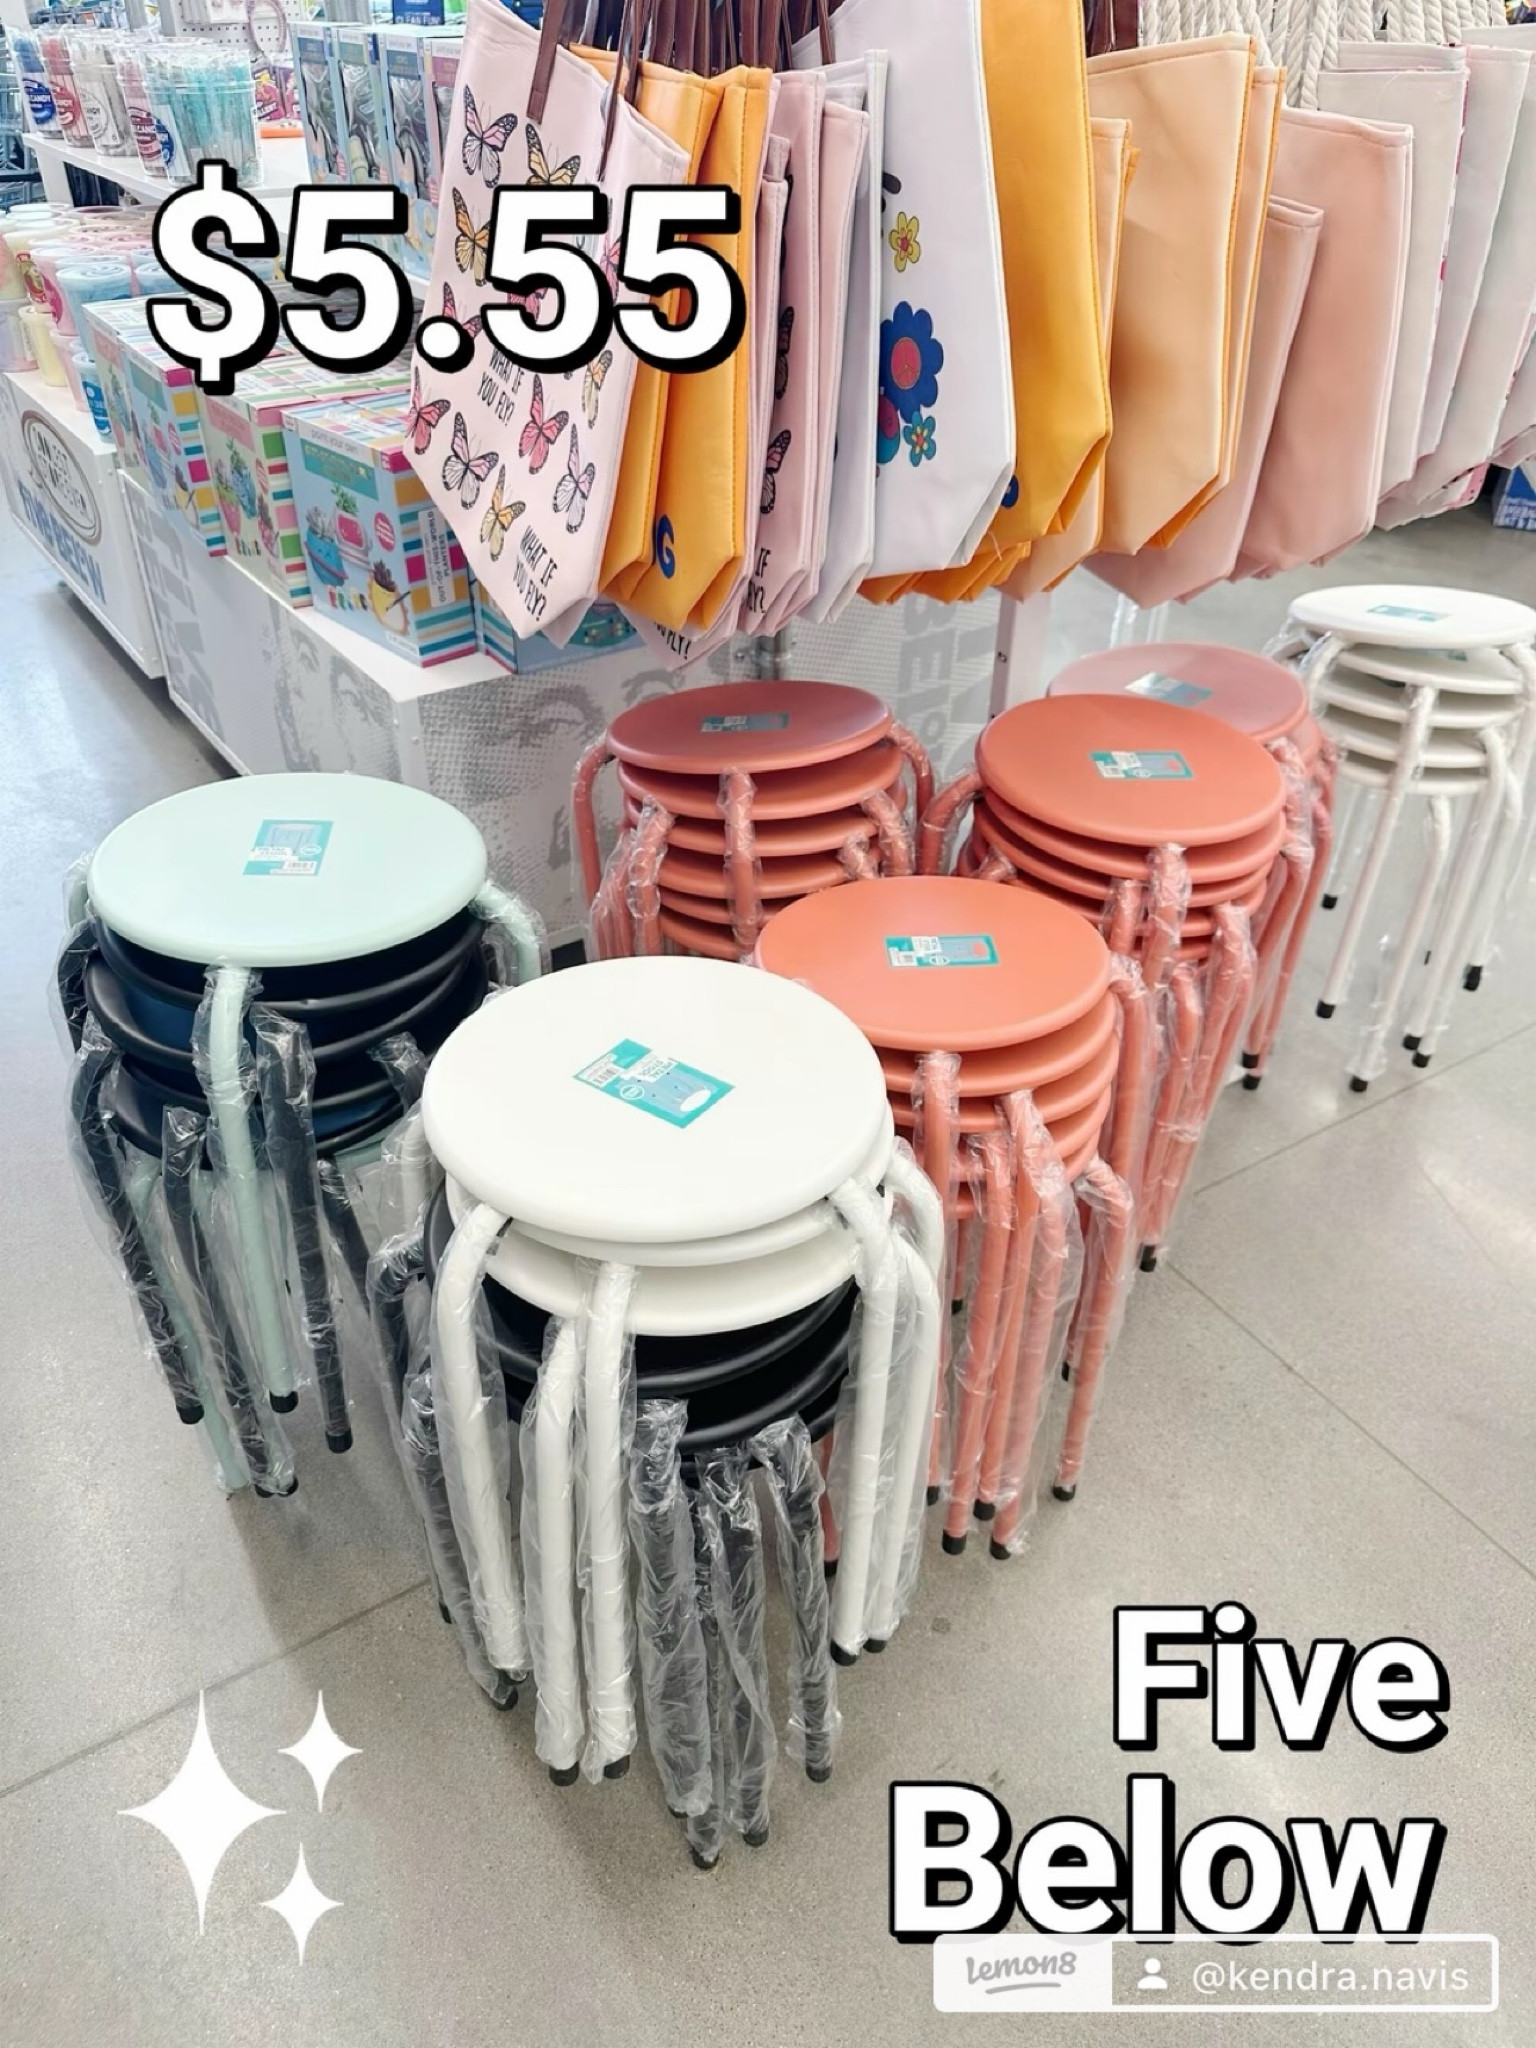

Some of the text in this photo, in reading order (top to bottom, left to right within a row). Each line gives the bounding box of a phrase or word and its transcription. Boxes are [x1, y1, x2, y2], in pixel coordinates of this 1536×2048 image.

[477, 371, 515, 427] YOU FLY?
[520, 524, 558, 588] WHAT IF
[754, 547, 771, 578] IF
[524, 579, 548, 622] FLY?
